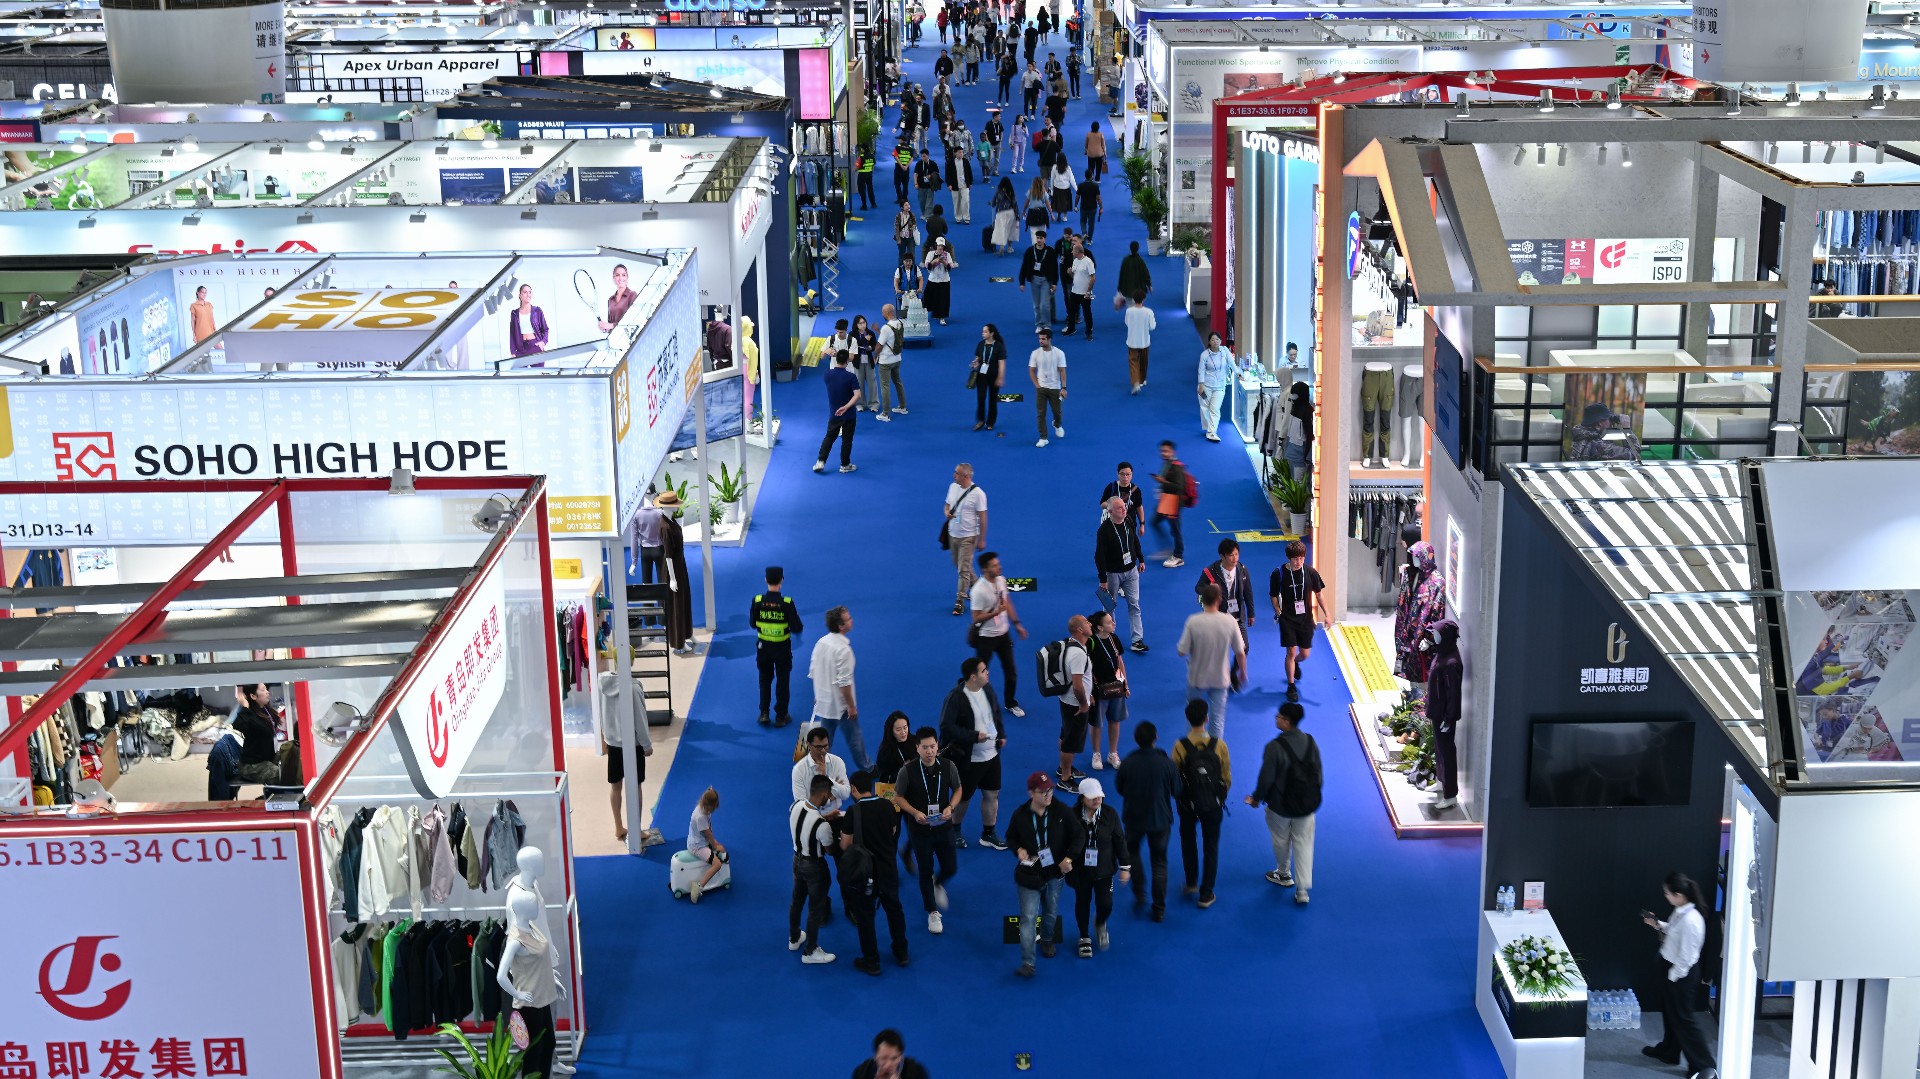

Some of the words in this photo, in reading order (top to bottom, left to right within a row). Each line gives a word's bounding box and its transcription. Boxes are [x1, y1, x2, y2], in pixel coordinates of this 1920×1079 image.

[255, 20, 274, 32] MORE
[343, 60, 382, 72] Apex
[387, 59, 433, 71] Urban
[437, 58, 500, 71] Apparel
[1177, 58, 1216, 66] Functional
[1218, 58, 1237, 66] Wool
[1363, 57, 1399, 66] Condition
[1230, 106, 1308, 116] 6.1E37-39,6.1F07-09
[1242, 130, 1279, 155] LOTO
[178, 268, 224, 277] SOHO
[293, 267, 336, 275] HE
[1652, 266, 1682, 281] ISPO
[134, 443, 258, 476] SOHO
[273, 442, 378, 474] HIGH
[393, 439, 508, 472] HOPE
[444, 604, 500, 710] 青岛即发集团
[1580, 666, 1650, 686] 凯喜雅集团
[1580, 684, 1615, 693] CATHAYA
[1617, 684, 1648, 692] GROUP
[171, 836, 288, 864] C10-11
